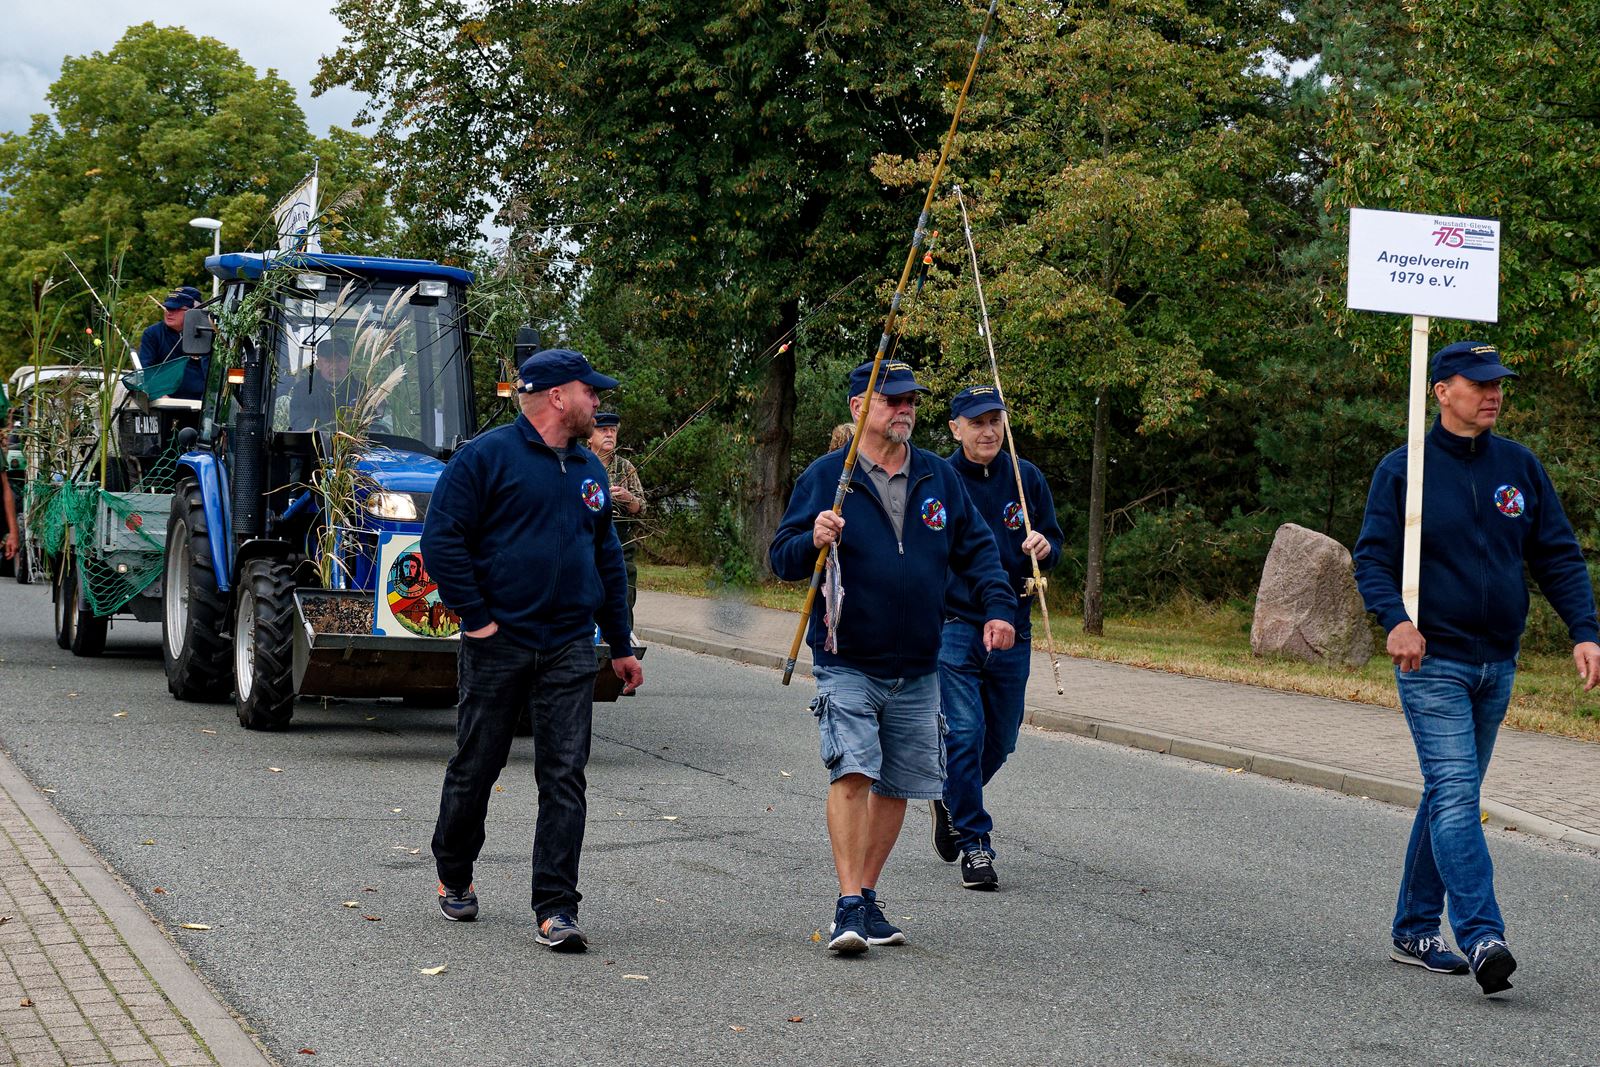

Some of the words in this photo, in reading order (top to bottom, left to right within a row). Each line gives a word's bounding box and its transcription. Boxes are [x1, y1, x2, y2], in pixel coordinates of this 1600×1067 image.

[1431, 226, 1464, 248] 775
[1377, 250, 1470, 270] Angelverein
[1389, 270, 1425, 285] 1979
[1428, 275, 1457, 288] e.V.
